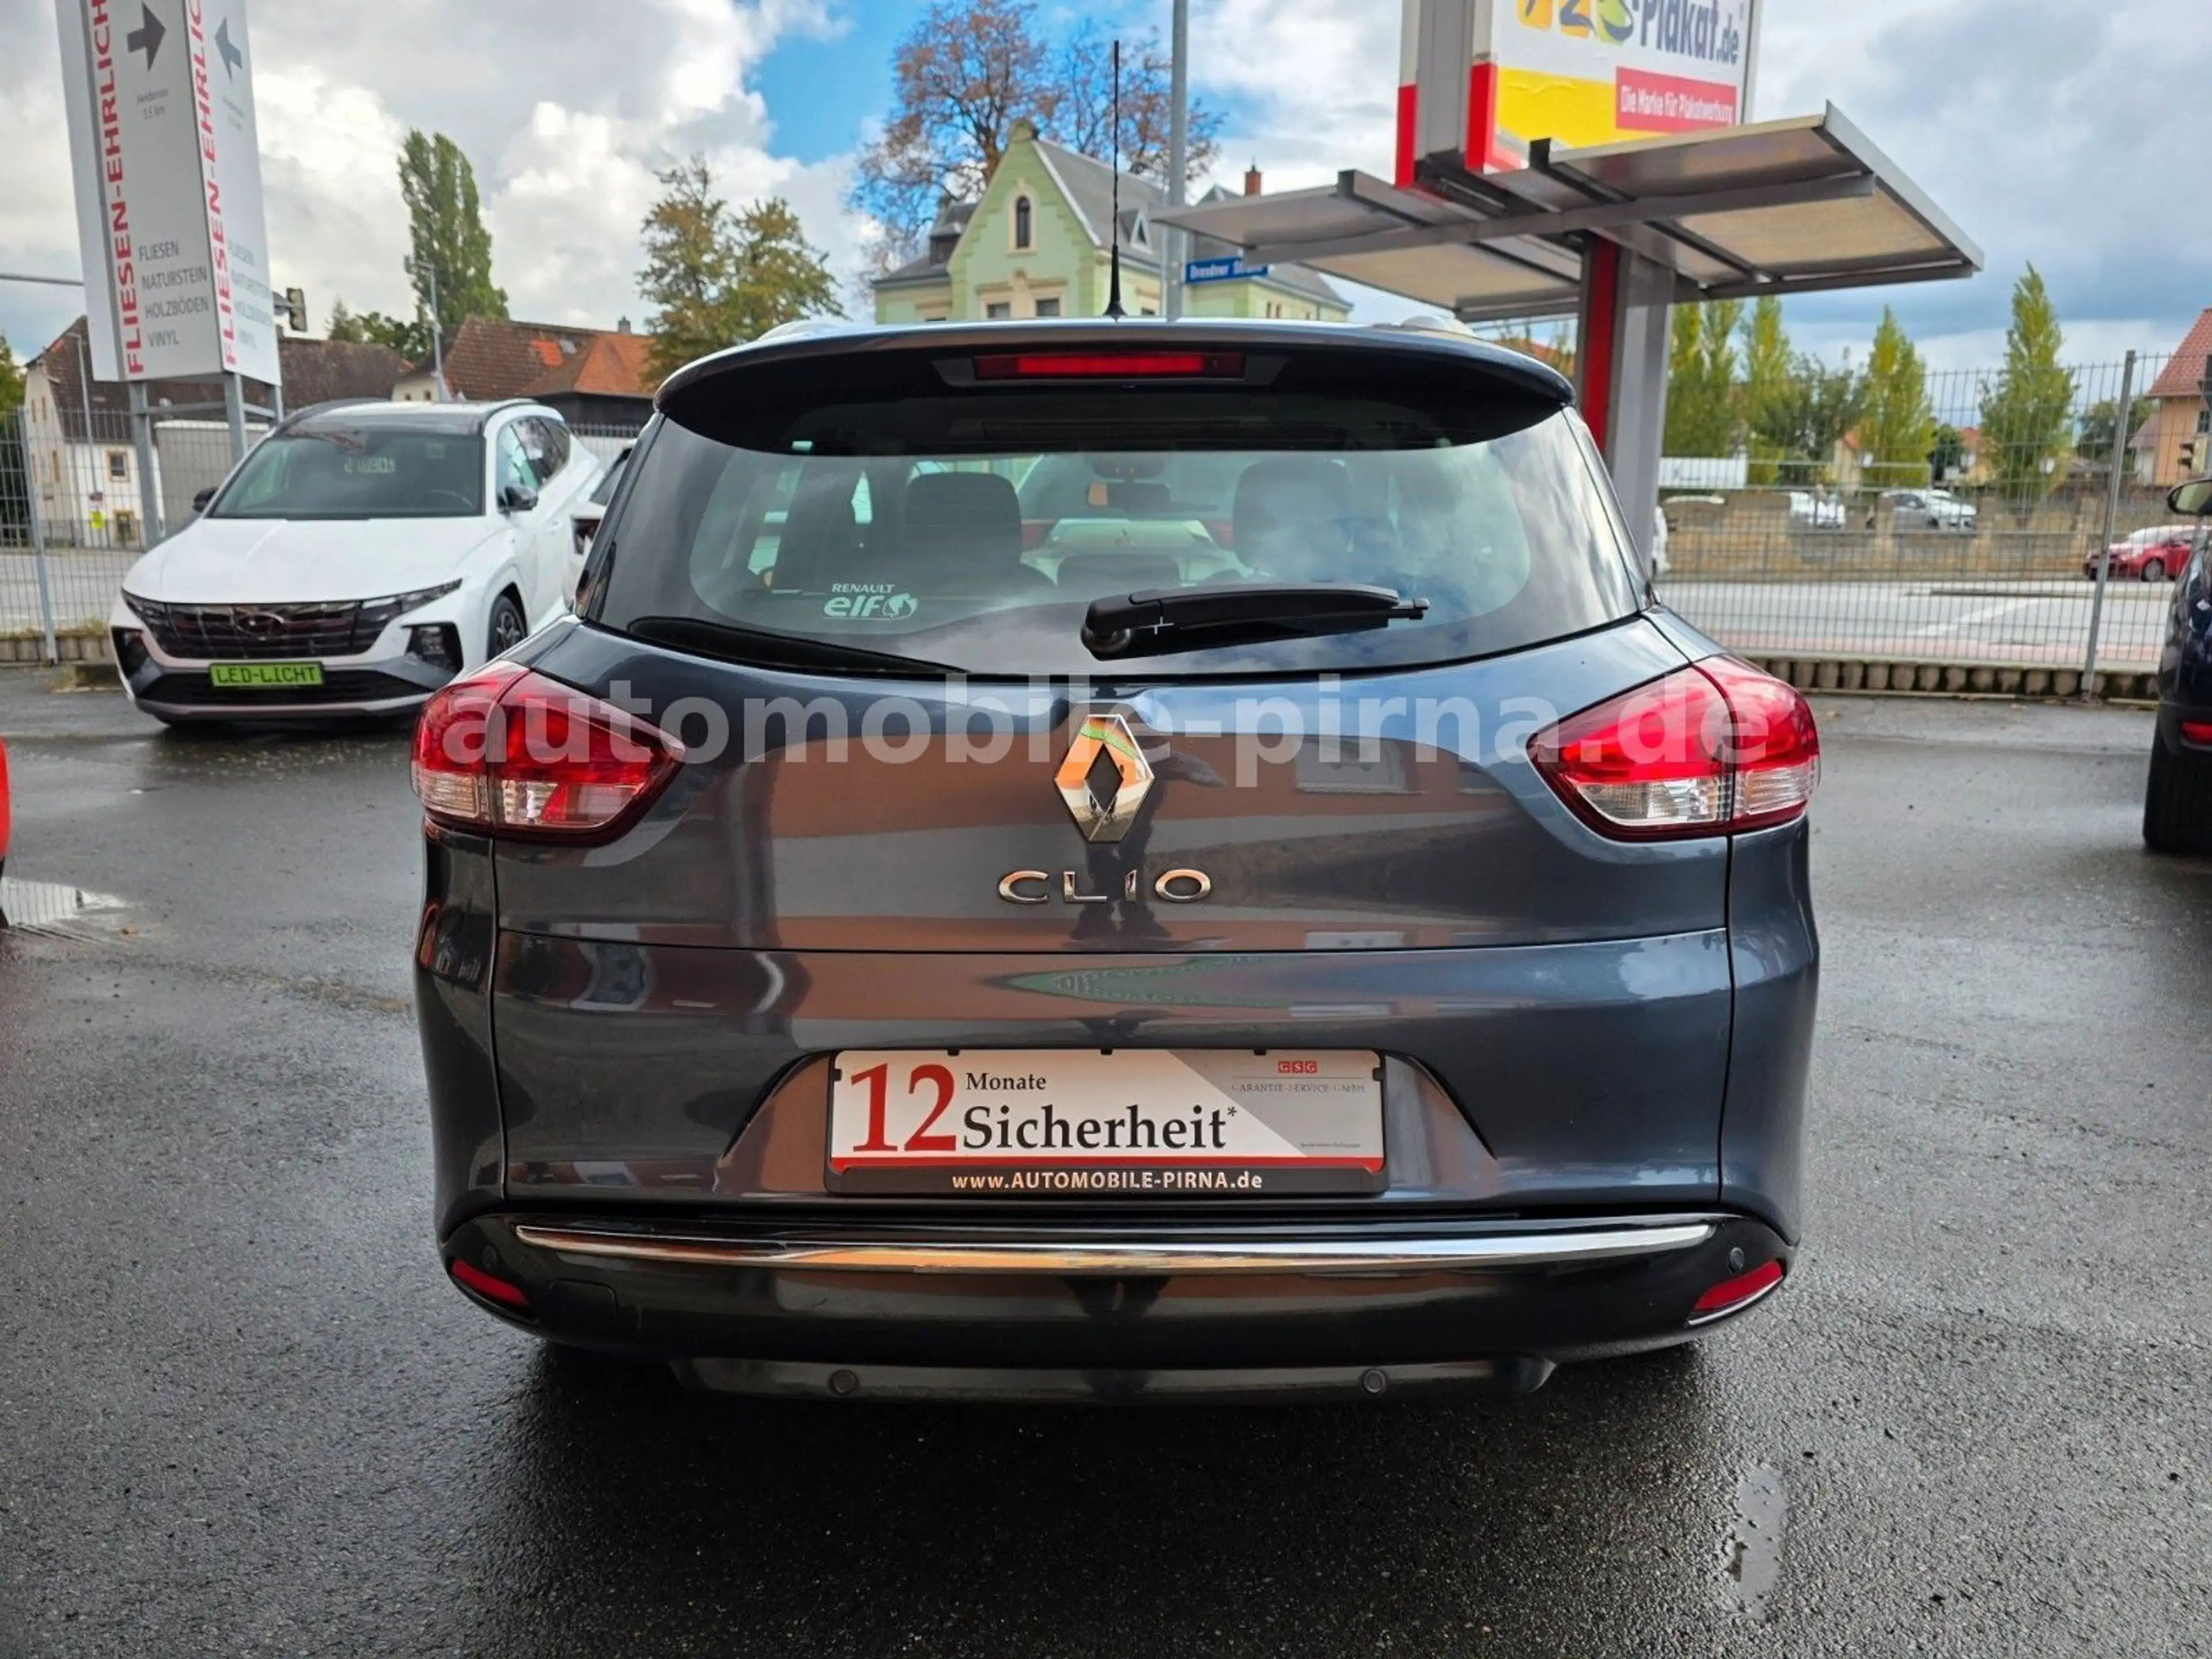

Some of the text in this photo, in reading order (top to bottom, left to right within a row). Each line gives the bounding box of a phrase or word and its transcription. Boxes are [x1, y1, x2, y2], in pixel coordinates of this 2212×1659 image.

[91, 0, 143, 374] FLIESEN-EHRLICH
[138, 238, 179, 261] FLIESEN
[141, 266, 207, 290] NATURSTEIN
[145, 294, 209, 319] HOLZBÖDEN
[147, 329, 180, 347] VINYL
[831, 583, 895, 593] RENAULT
[823, 595, 885, 617] elf
[215, 666, 316, 683] LED-LICHT
[998, 869, 1211, 903] CLIO
[1278, 1060, 1317, 1074] GSG
[965, 1072, 1047, 1090] Monate
[850, 1062, 957, 1152] 12
[952, 1171, 1263, 1189] www.AUTOMOBILE-PIRNA.de
